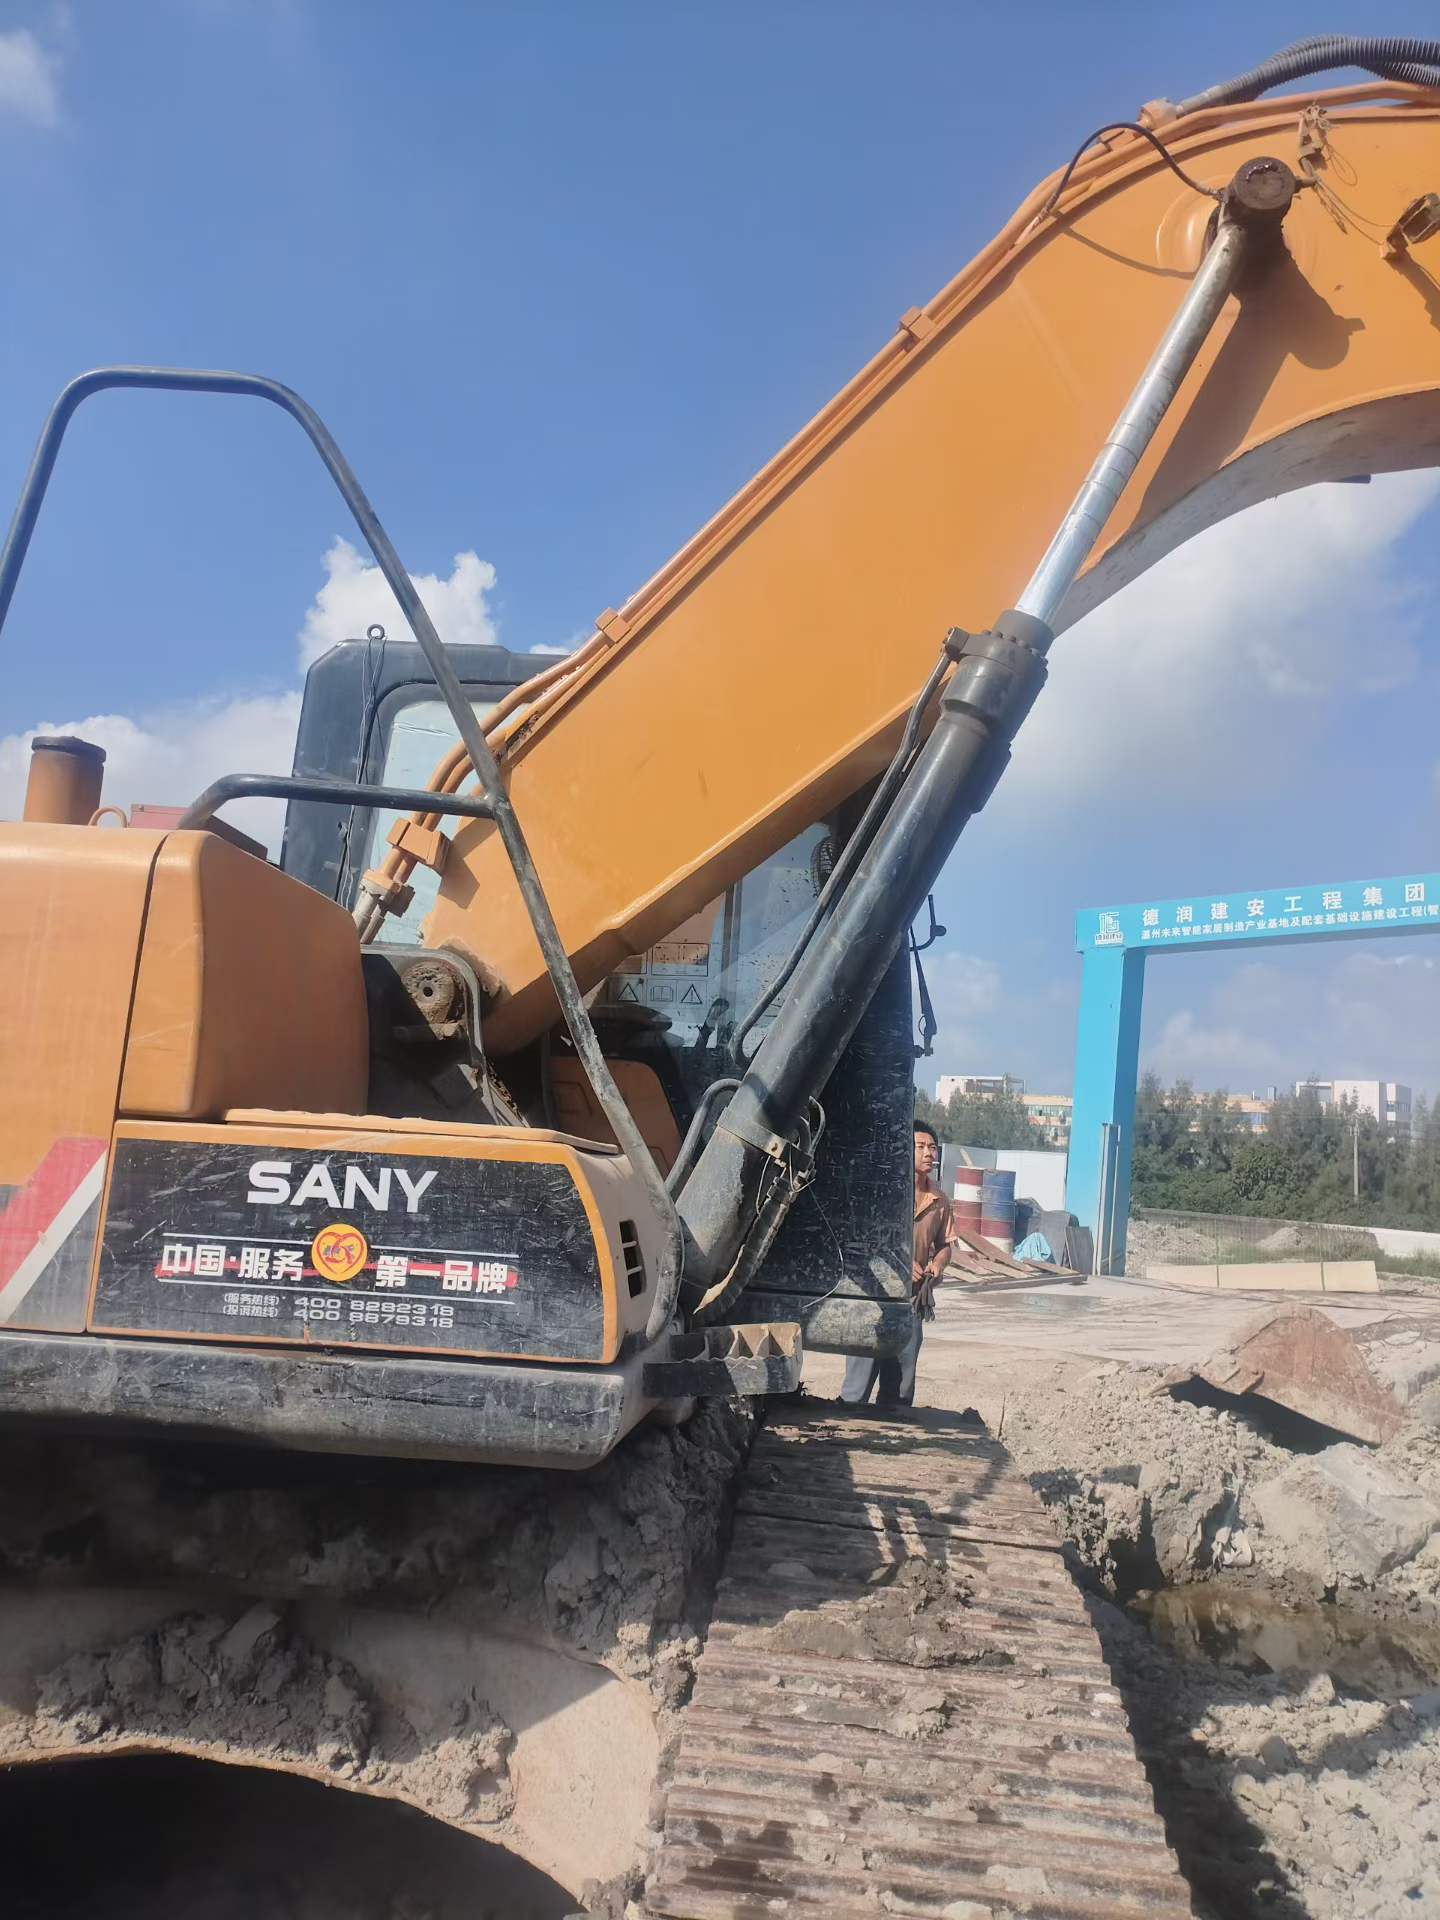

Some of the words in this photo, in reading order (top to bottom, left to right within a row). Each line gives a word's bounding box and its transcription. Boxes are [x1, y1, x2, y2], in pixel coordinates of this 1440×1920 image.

[1142, 882, 1425, 926] 德润建安工程集团
[247, 1161, 439, 1213] SANY
[374, 1255, 508, 1294] 第一品牌
[293, 1309, 340, 1321] 400
[349, 1312, 454, 1329] 8879318
[294, 1296, 341, 1309] 400
[350, 1300, 454, 1316] 8282318
